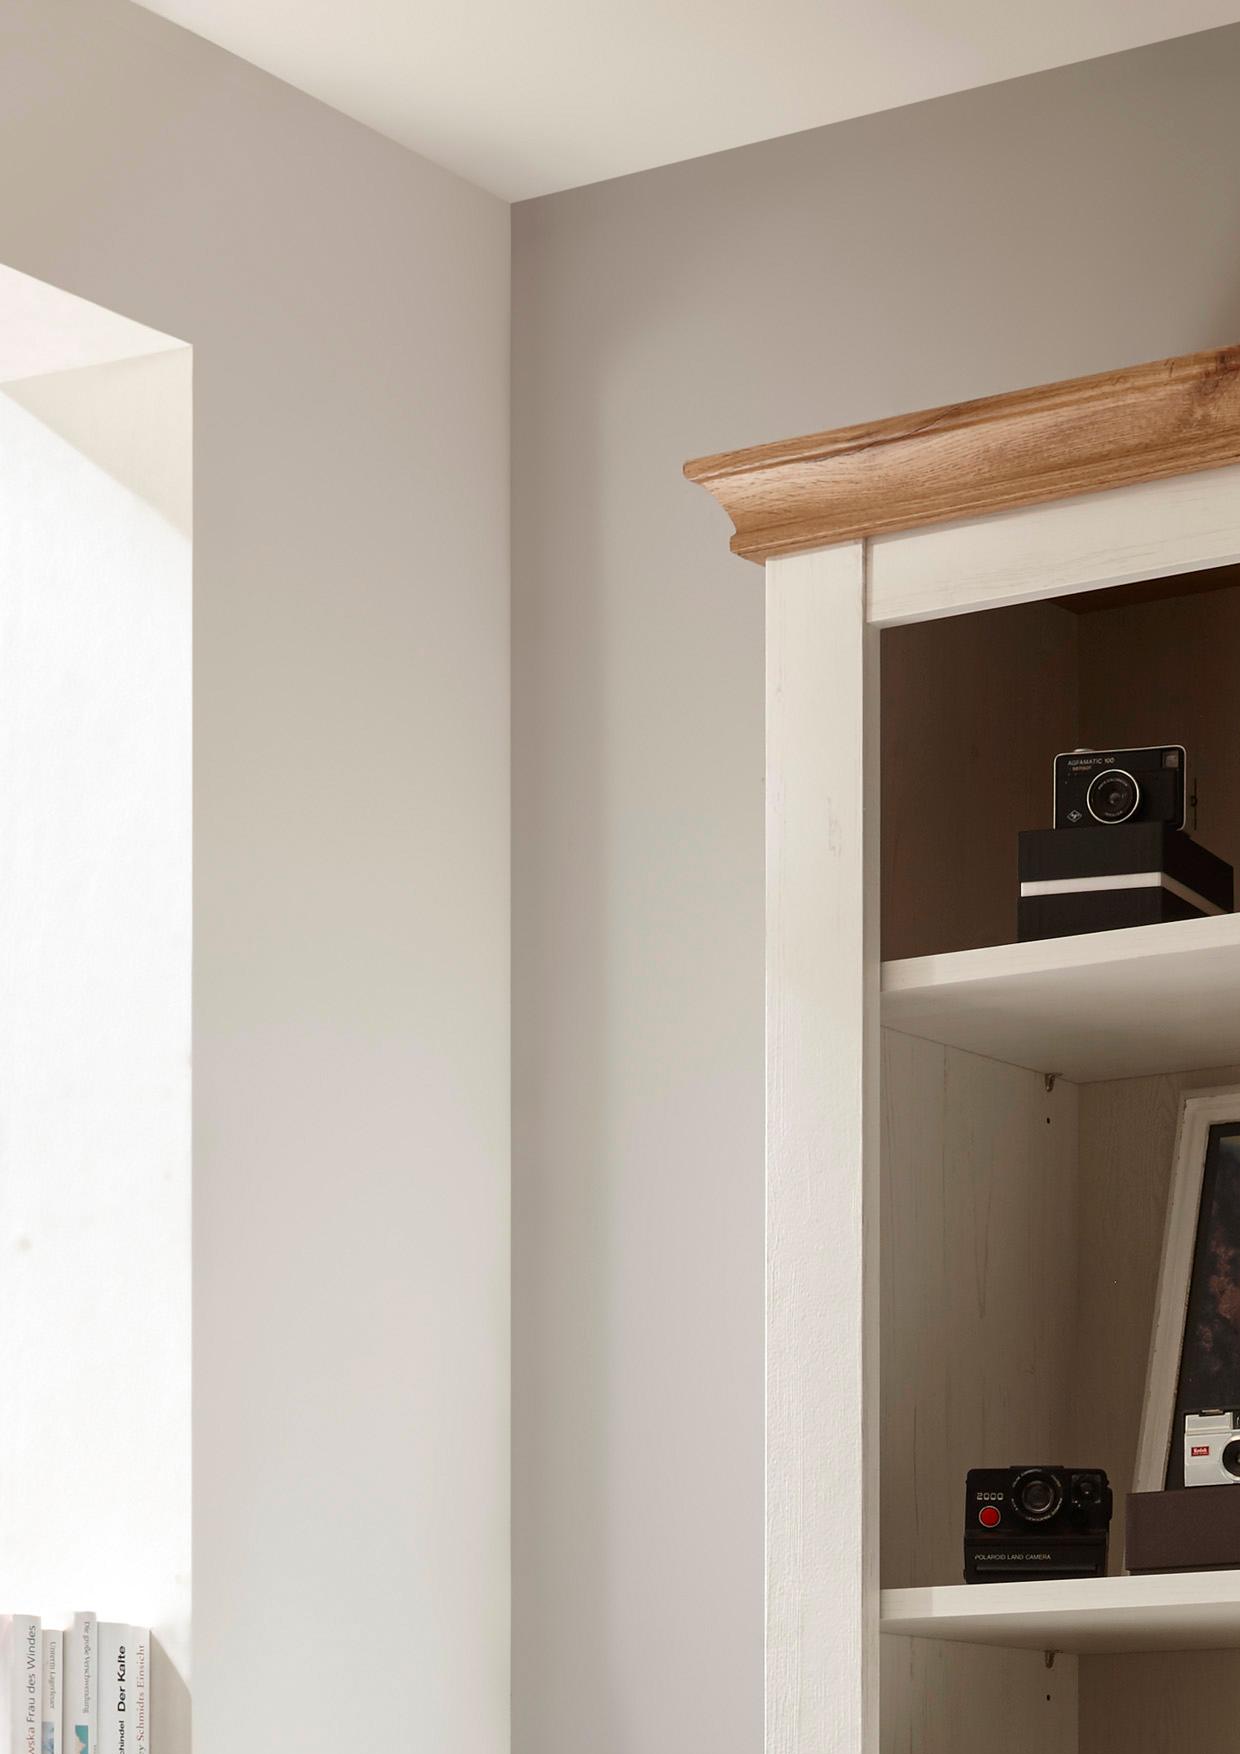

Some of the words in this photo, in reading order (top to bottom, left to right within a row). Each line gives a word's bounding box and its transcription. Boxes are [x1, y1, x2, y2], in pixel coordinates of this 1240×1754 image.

[976, 1492, 1004, 1500] 2000
[28, 1624, 36, 1670] Windes
[117, 1645, 126, 1682] Kalte
[136, 1644, 145, 1688] Einsicht
[28, 1674, 36, 1694] des
[117, 1685, 126, 1712] Der
[27, 1697, 35, 1724] Frau
[136, 1691, 145, 1741] Schmidts
